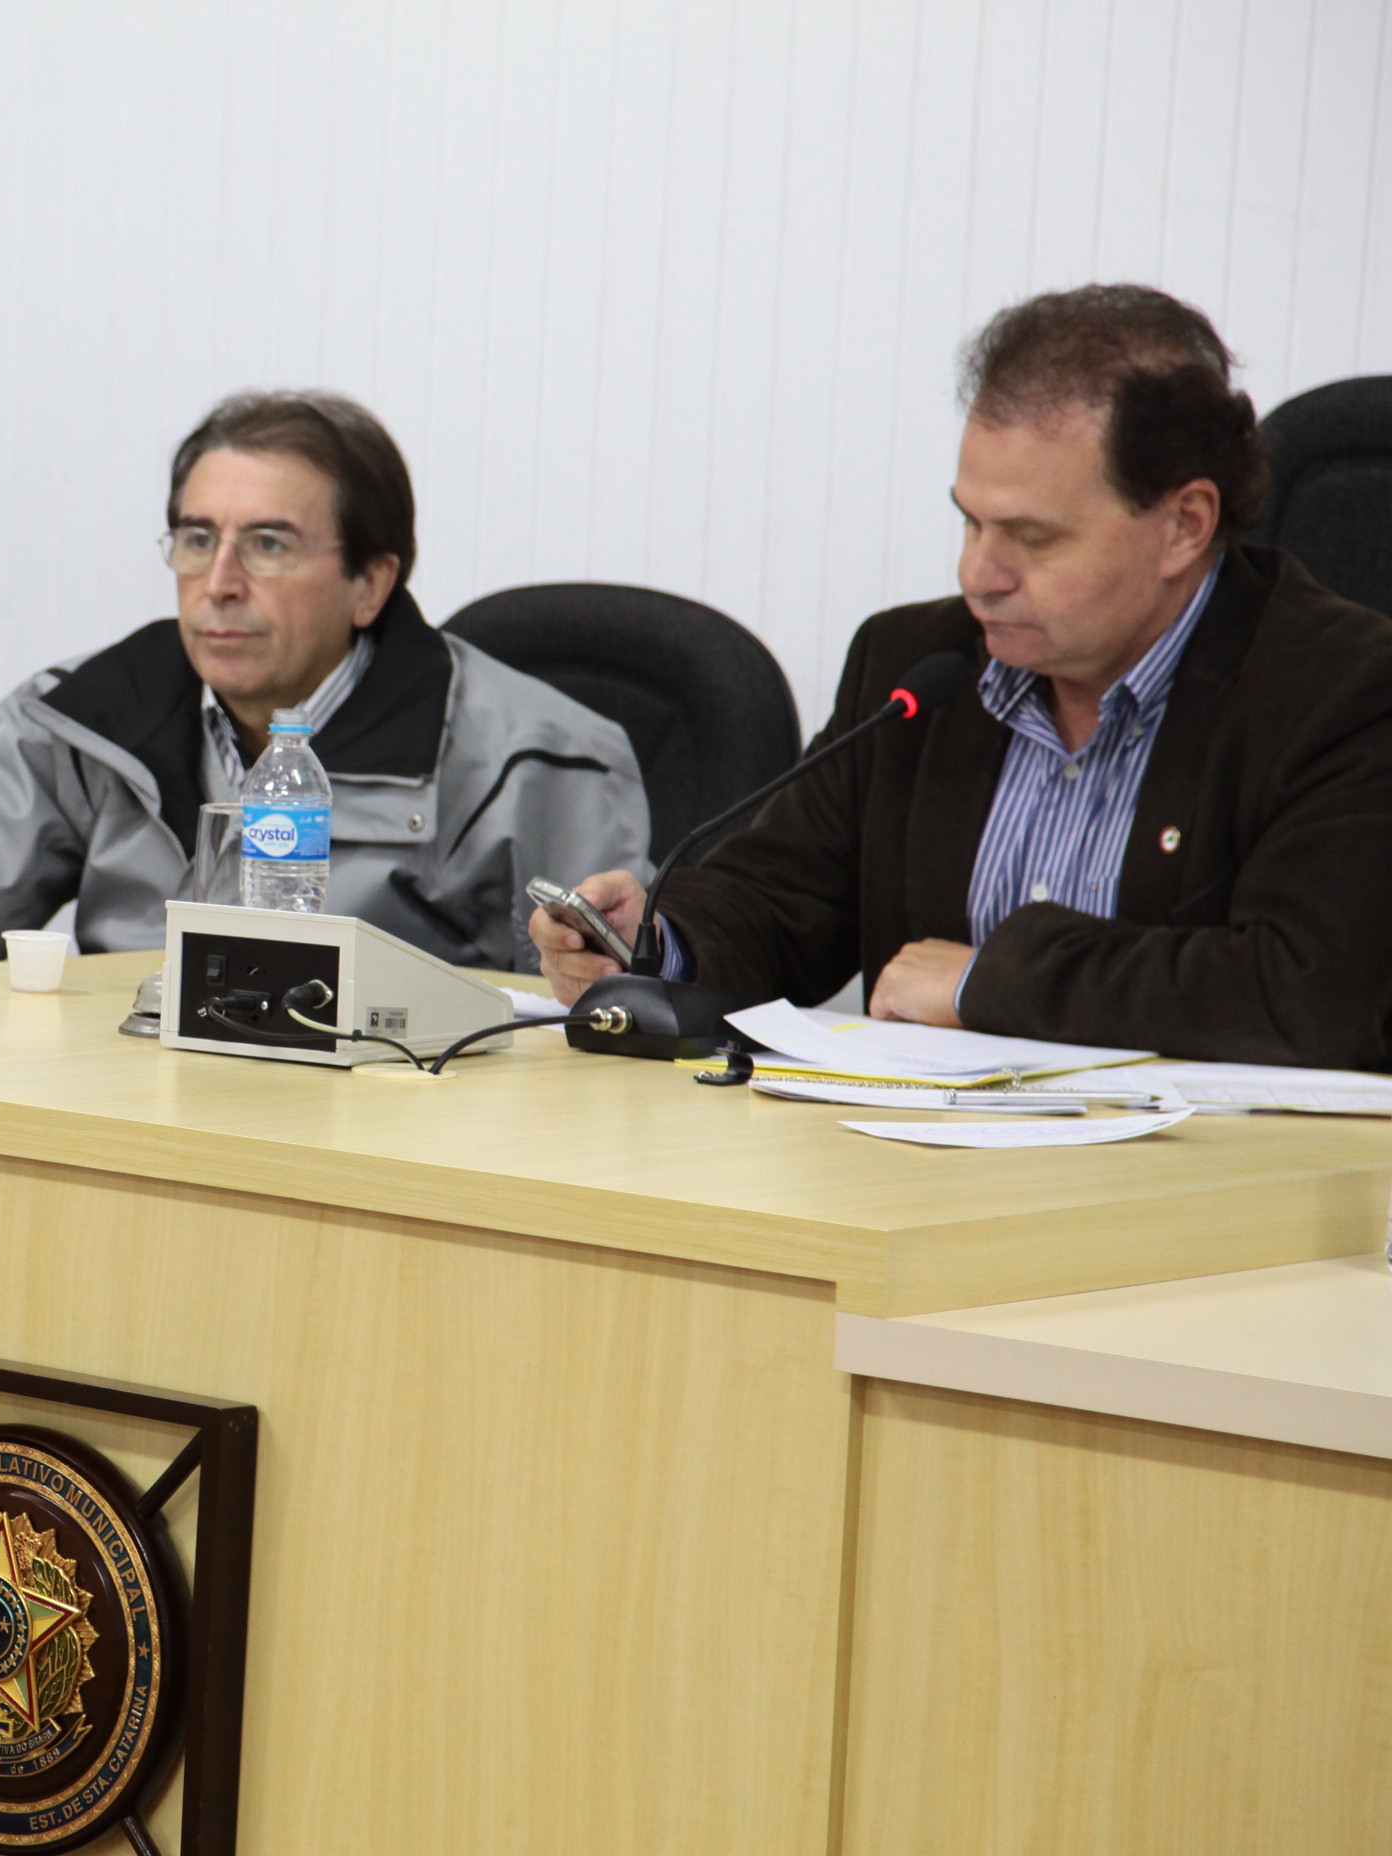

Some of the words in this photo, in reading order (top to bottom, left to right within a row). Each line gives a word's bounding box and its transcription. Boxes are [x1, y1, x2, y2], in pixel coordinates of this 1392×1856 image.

[248, 827, 295, 842] crystal
[65, 1484, 146, 1621] MUNICIPAL
[10, 1763, 24, 1775] de
[33, 1747, 60, 1771] 1889
[29, 1811, 62, 1831] EST.
[62, 1798, 83, 1820] DE
[82, 1776, 113, 1804] STA.
[109, 1685, 148, 1773] CATARINA
